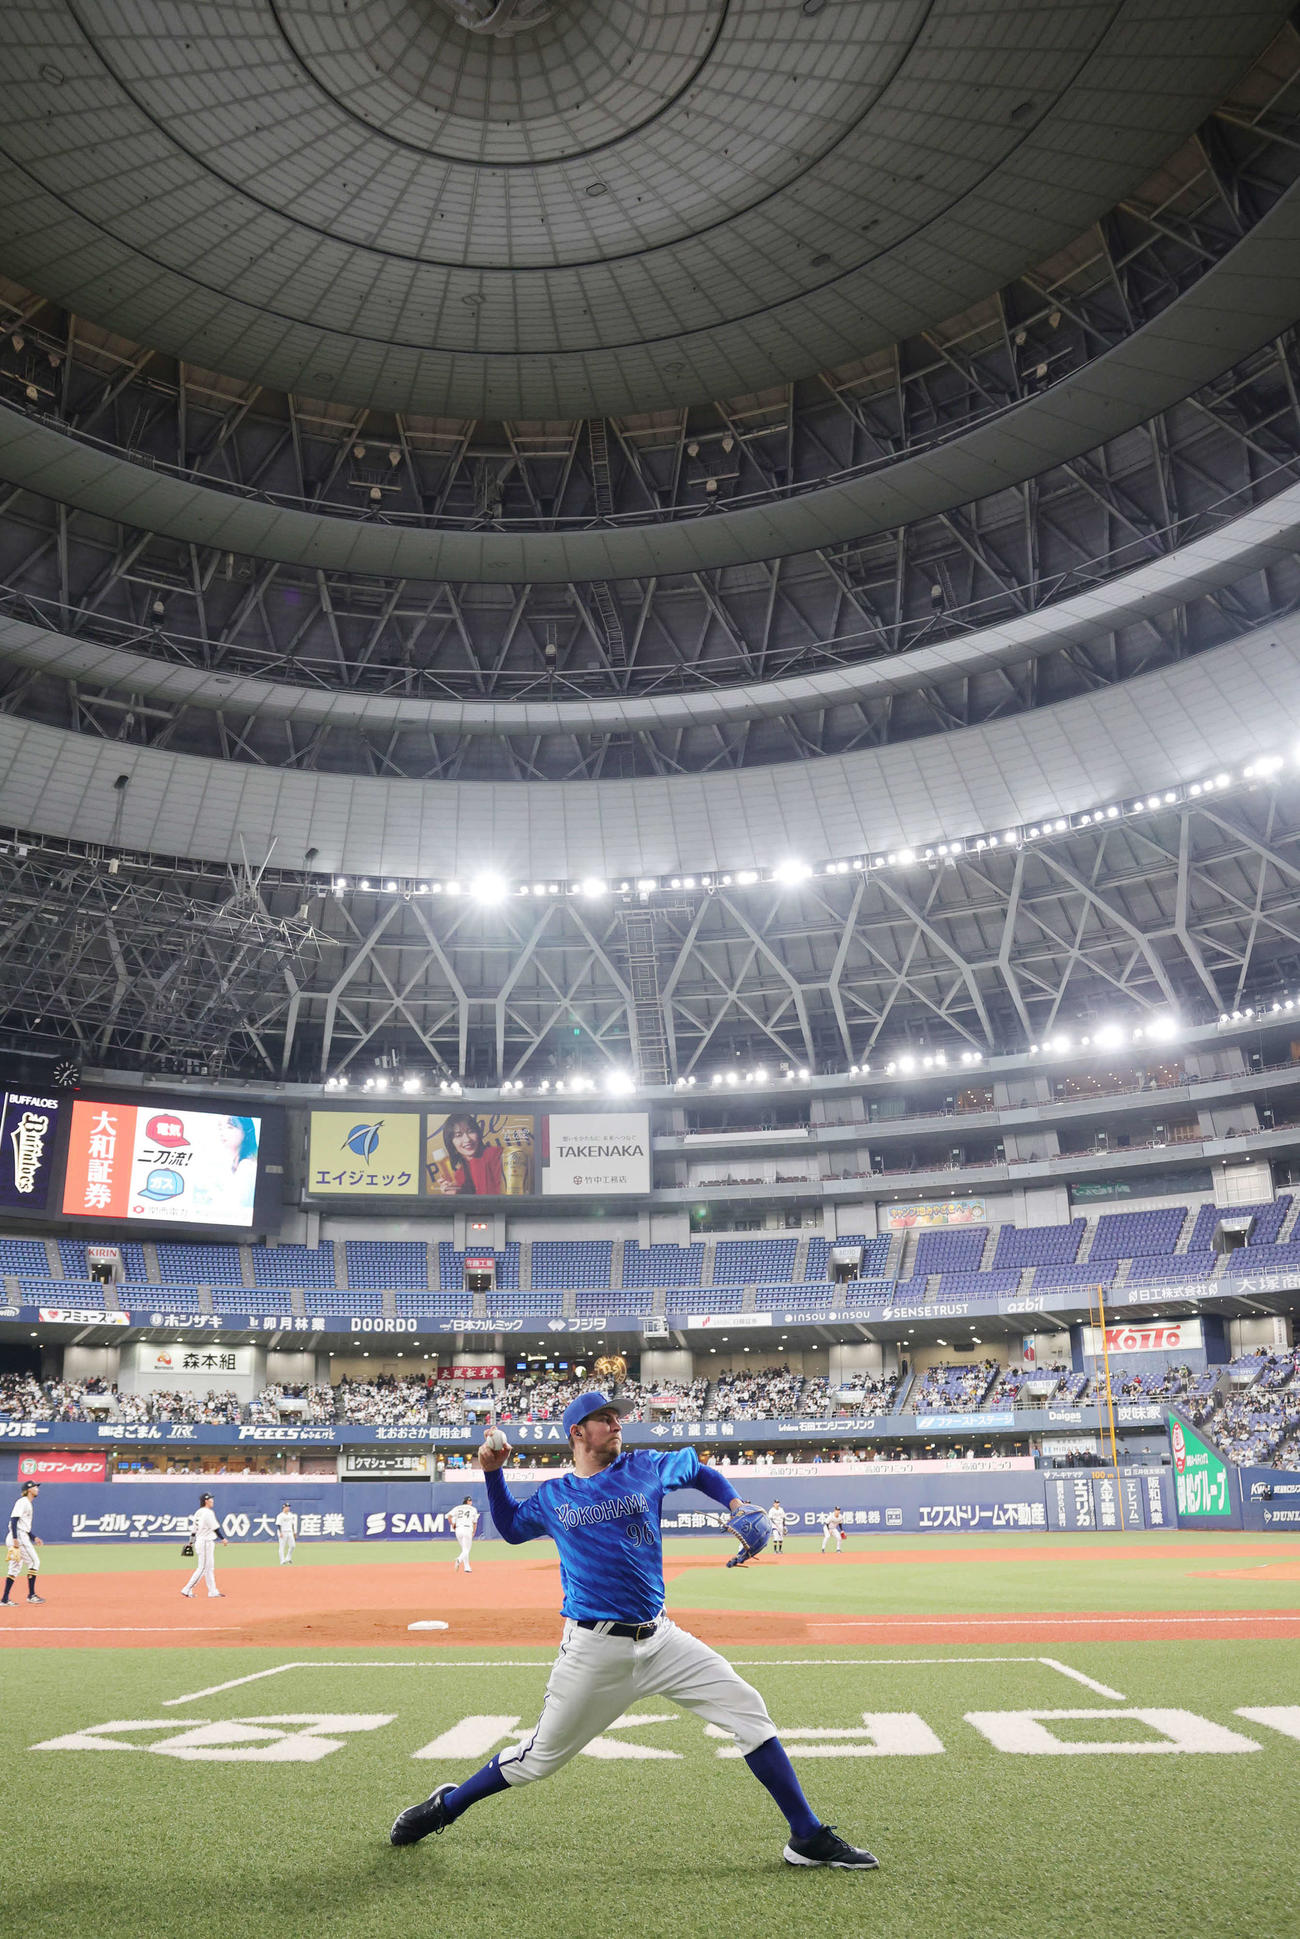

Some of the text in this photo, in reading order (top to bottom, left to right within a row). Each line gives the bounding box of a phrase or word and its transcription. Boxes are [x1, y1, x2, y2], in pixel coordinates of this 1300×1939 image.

[9, 1094, 58, 1110] BUFFALOES
[156, 1122, 182, 1138] 電気
[555, 1145, 644, 1158] TAKENAKA
[84, 1110, 118, 1210] 大和証券
[150, 1176, 174, 1191] ガス
[316, 1170, 412, 1187] エイジェック
[584, 1175, 627, 1184] 竹中工務店
[88, 1248, 117, 1257] KIRIN
[1139, 1284, 1209, 1301] 日工株式会社
[893, 1303, 969, 1318] SENSE TRUST
[1007, 1299, 1044, 1313] azbil
[62, 1311, 113, 1322] アミューズ
[164, 1315, 223, 1328] ホシザキ
[568, 1318, 607, 1330] フジタ
[263, 1318, 326, 1331] 卯月林業
[351, 1318, 417, 1332] DOORDO
[453, 1319, 523, 1331] 日本カルミック
[182, 1353, 236, 1370] 森本組
[938, 1416, 1013, 1427] ファーストステージ
[1049, 1410, 1081, 1421] Daigas
[376, 1427, 472, 1440] 北おおさか信用金庫
[534, 1426, 569, 1439] SA
[1074, 1479, 1090, 1527] エコリカ
[1127, 1484, 1139, 1519] エレコム
[1147, 1476, 1164, 1524] 阪和興業
[457, 1511, 470, 1519] 24
[554, 1493, 650, 1531] YOKOHAMA
[804, 1510, 880, 1525] 日本信機器
[919, 1502, 1045, 1527] エクスドリーム不動産
[252, 1513, 345, 1537] 大産業
[391, 1513, 480, 1533] SAM
[626, 1521, 655, 1548] 96
